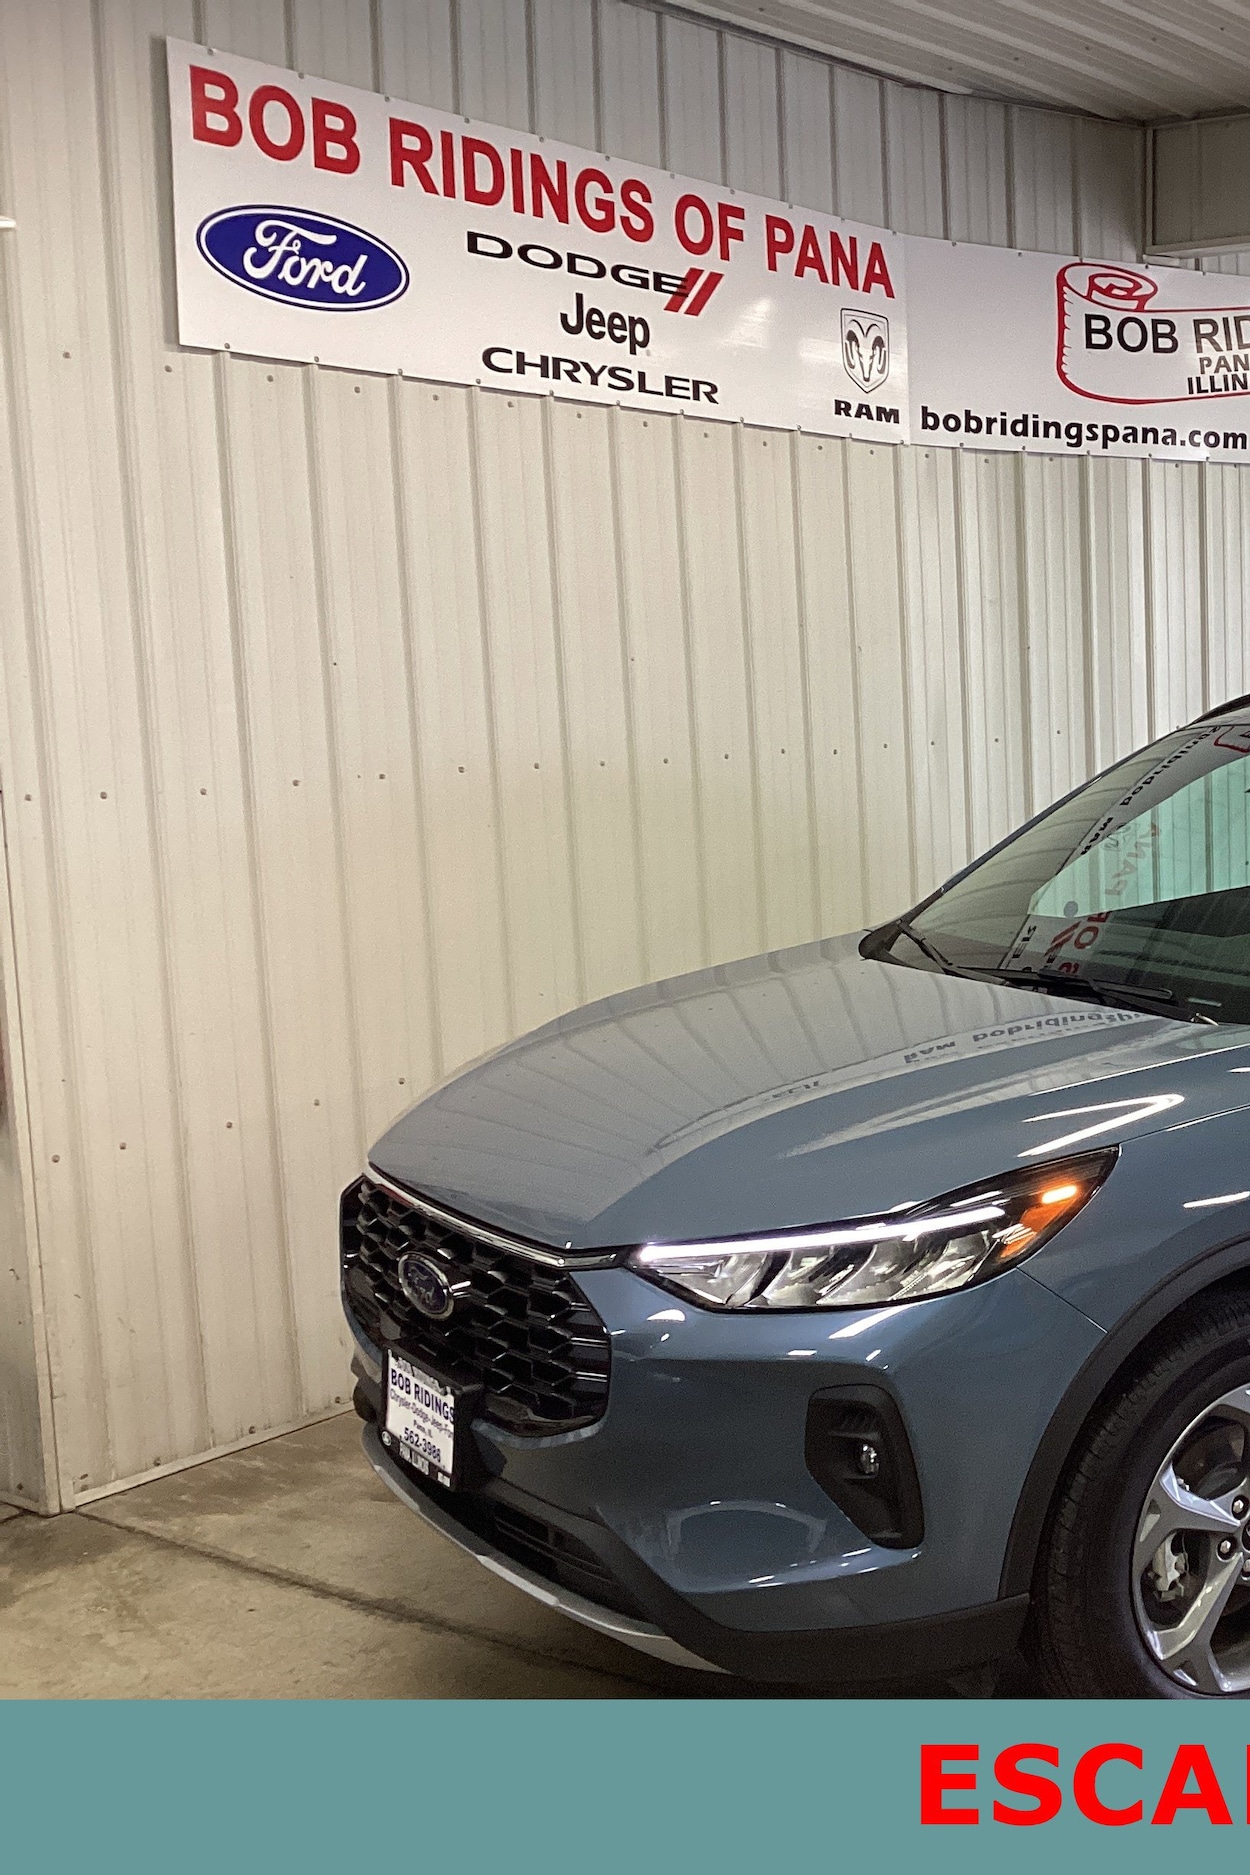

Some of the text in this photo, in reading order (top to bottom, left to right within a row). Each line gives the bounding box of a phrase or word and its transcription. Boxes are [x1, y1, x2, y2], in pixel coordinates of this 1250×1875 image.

[189, 65, 896, 299] BOB RIDINGS OF PANA
[243, 219, 368, 297] Ford
[466, 230, 688, 296] DODGE
[560, 292, 651, 353] Jeep
[1084, 313, 1179, 354] BOB
[482, 346, 720, 404] CHRYSLER
[834, 399, 900, 425] RAM
[920, 405, 1248, 450] bobridingspana.com
[391, 1367, 411, 1395] BOB
[414, 1383, 455, 1425] RIDINGS
[404, 1426, 441, 1462] 562-3986
